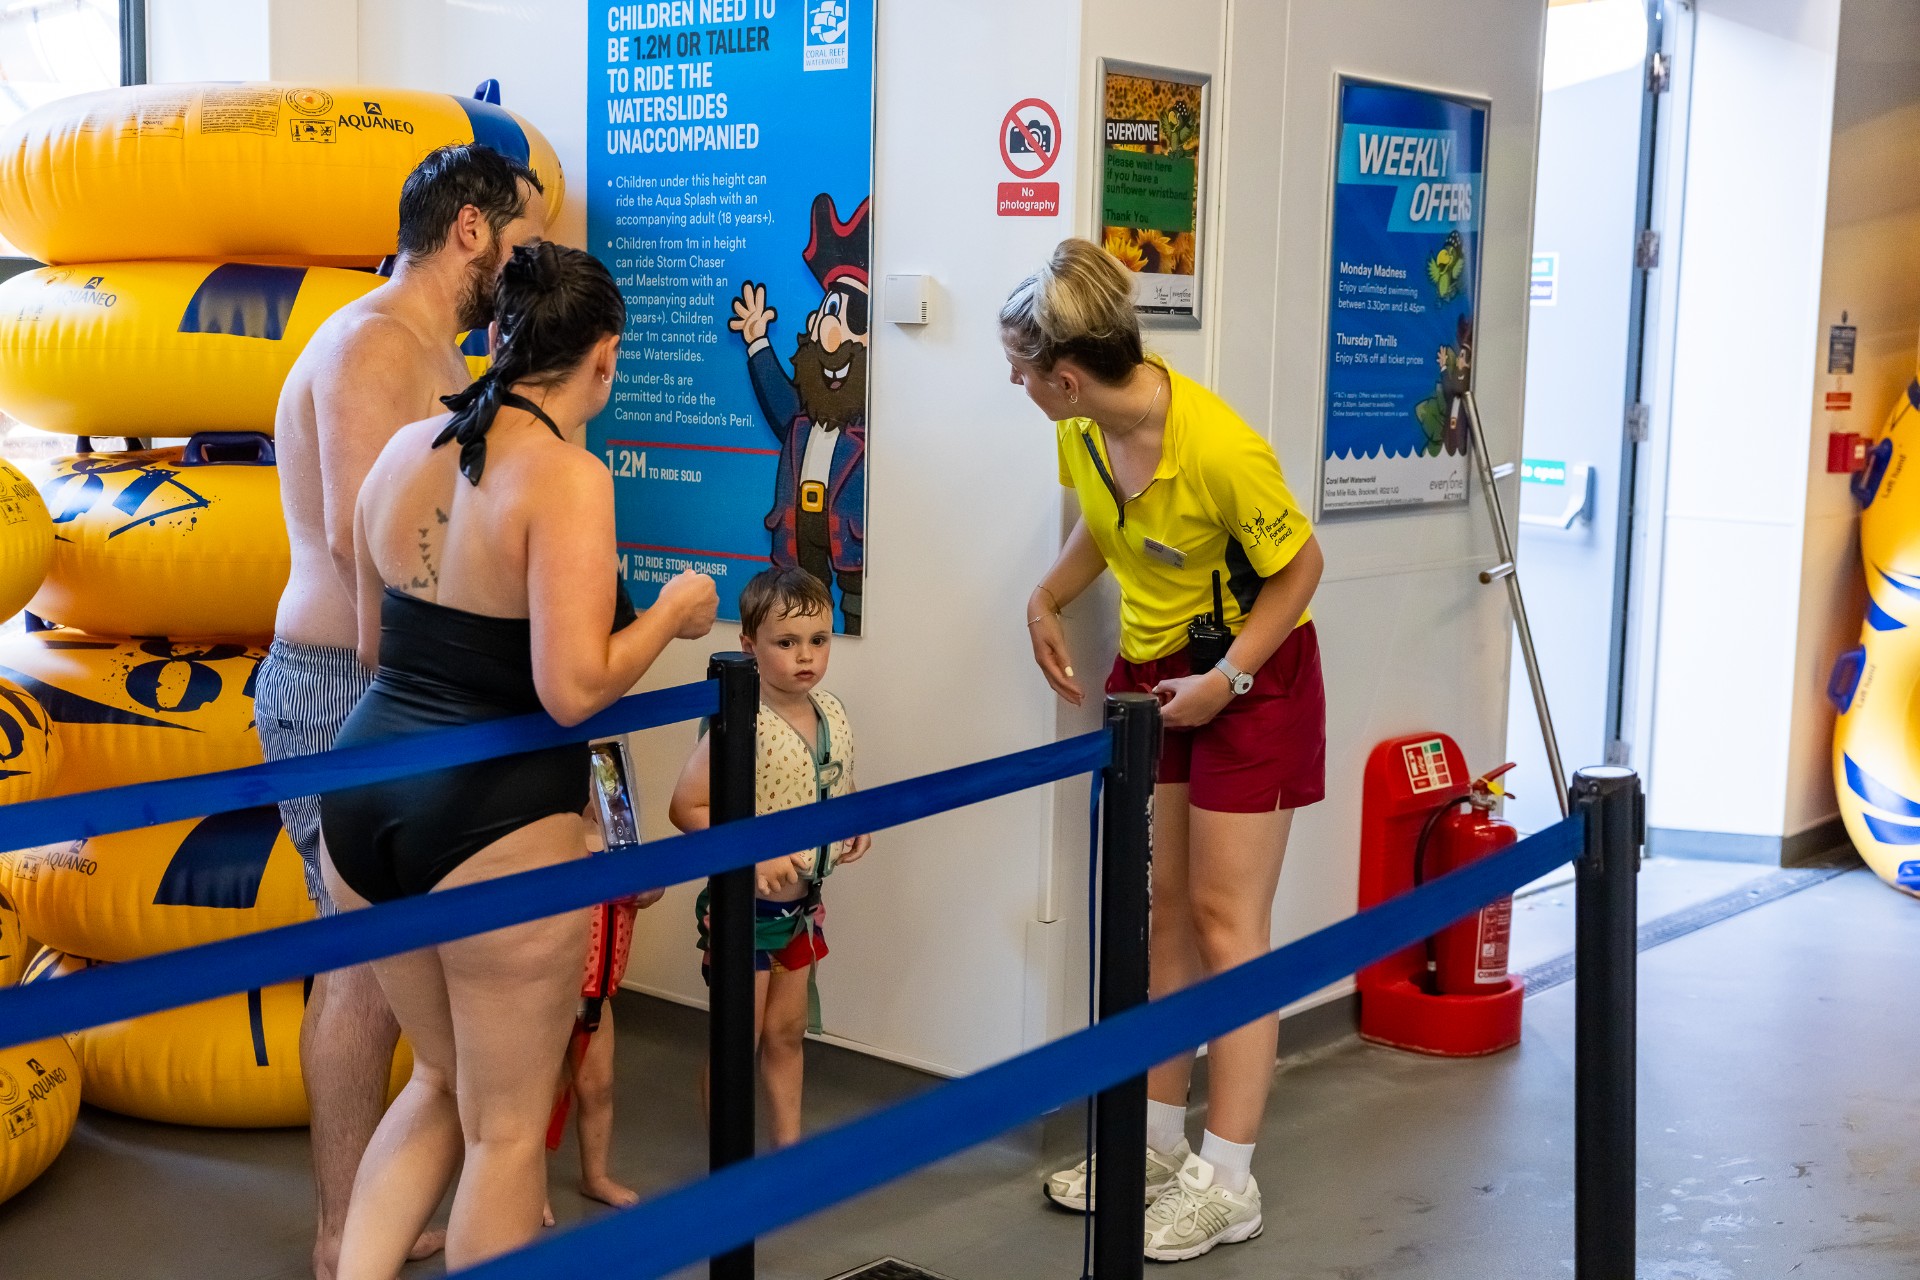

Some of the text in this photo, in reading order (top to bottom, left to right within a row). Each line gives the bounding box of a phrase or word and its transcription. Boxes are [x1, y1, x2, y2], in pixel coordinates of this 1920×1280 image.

[607, 0, 694, 32] CHILDREN
[700, 0, 747, 25] NEED
[607, 26, 770, 63] BE 1.2M OR TALLER
[805, 48, 845, 59] CORAL REEF
[805, 57, 846, 66] WATERWORLD
[607, 62, 713, 93] TO RIDE THE
[607, 93, 728, 124] WATERSLIDES
[338, 114, 414, 135] AQUANEO
[1106, 122, 1158, 142] EVERYONE
[607, 123, 759, 155] UNACCOMPANIED
[1107, 155, 1173, 173] Please wait here
[1359, 133, 1451, 178] WEEKLY
[616, 173, 767, 189] Children under this height can
[1106, 167, 1159, 185] if you have a
[1021, 187, 1035, 197] No
[1106, 183, 1147, 196] sunflower
[616, 192, 758, 209] ride the Aqua Splash with an
[1000, 199, 1056, 212] photography
[1409, 182, 1472, 222] OFFERS
[616, 209, 775, 228] accompanying adult (18 years+).
[1105, 208, 1149, 223] Thank You
[615, 236, 747, 252] Children from 1m in height
[615, 254, 726, 268] can ride Storm Chaser
[1340, 261, 1407, 279] Monday Madness
[615, 273, 728, 287] and Maelstrom with an
[54, 289, 117, 308] QUANEO
[1339, 281, 1418, 299] Enjoy unlimited swimming
[622, 292, 715, 308] ccompanying adult
[1338, 298, 1365, 309] between
[1367, 300, 1390, 312] 3.30pm
[1391, 302, 1403, 312] and
[630, 310, 669, 326] years+).
[671, 311, 714, 325] Children
[621, 328, 718, 344] nder 1m cannot ride
[1337, 332, 1398, 348] Thursday Thrills
[643, 348, 705, 362] Waterslides.
[1335, 352, 1424, 366] Enjoy 50% off all ticket prices
[615, 370, 694, 386] No under-8s are
[615, 390, 716, 406] permitted to ride the
[615, 408, 755, 428] Cannon and Poseidon's Peril.
[605, 449, 702, 483] 1.2M TO RIDE SOLO
[1274, 527, 1293, 547] Council
[616, 553, 728, 580] M TO RIDE STORM CHASER
[633, 569, 650, 581] AND
[42, 851, 98, 876] AQUANEO
[28, 1067, 67, 1105] AQUANEO
